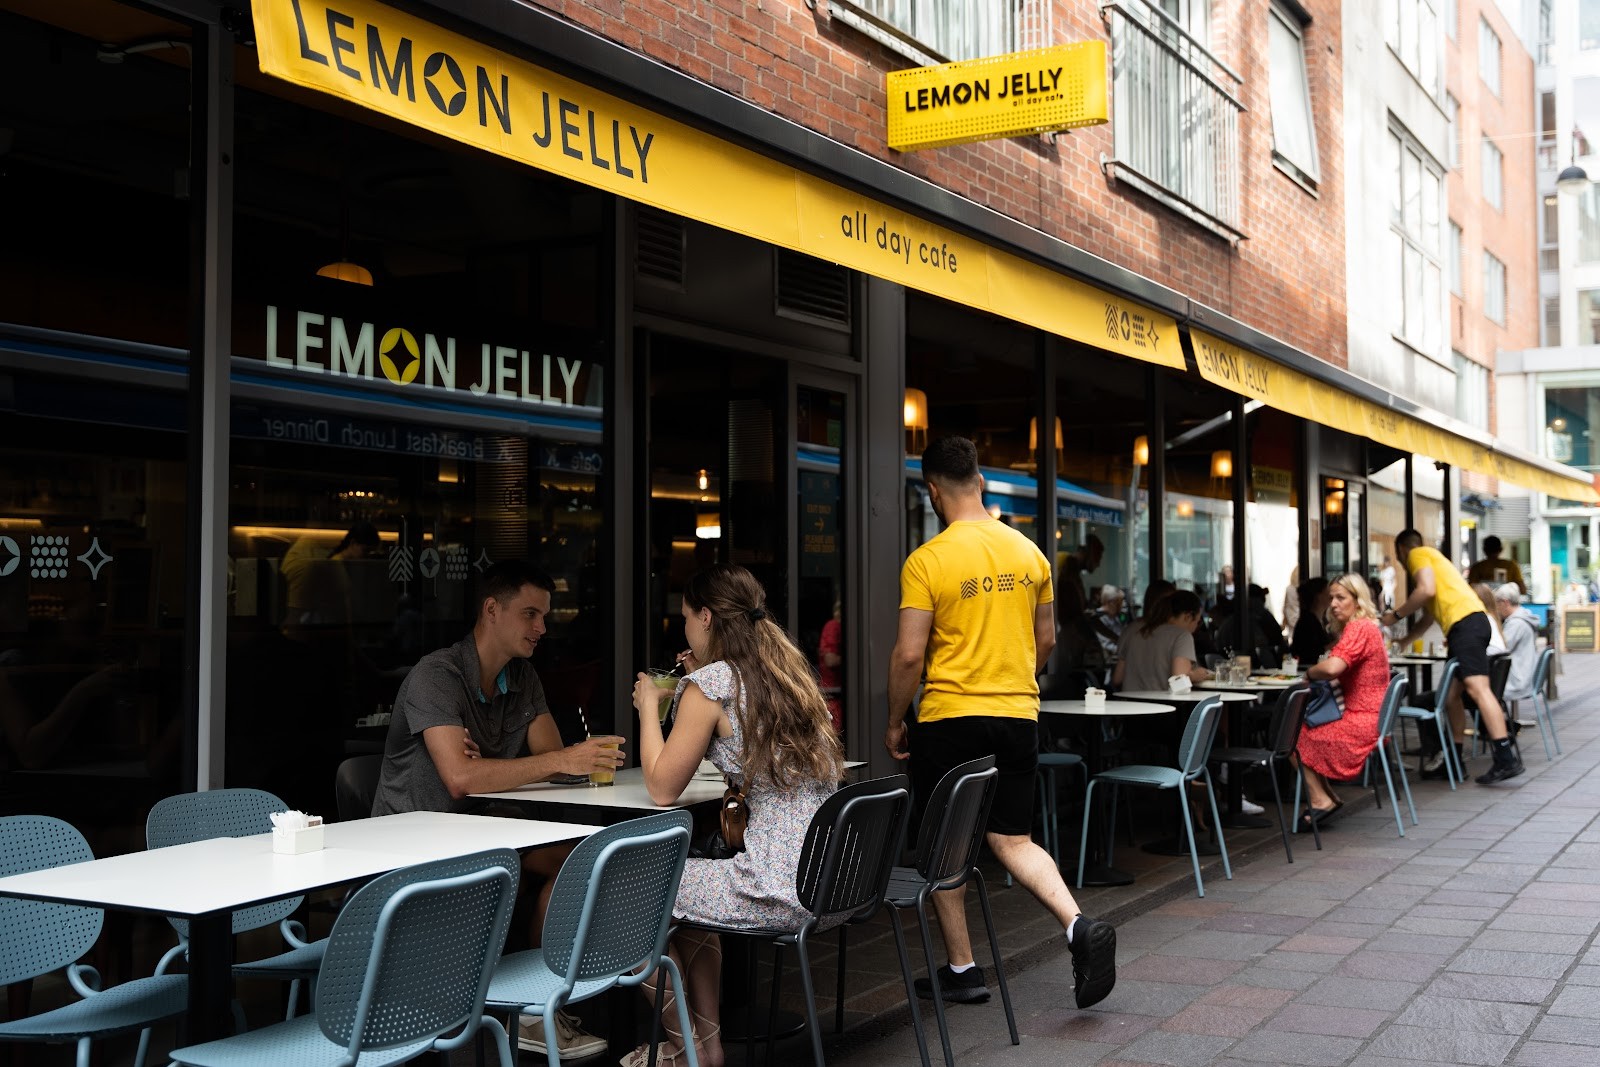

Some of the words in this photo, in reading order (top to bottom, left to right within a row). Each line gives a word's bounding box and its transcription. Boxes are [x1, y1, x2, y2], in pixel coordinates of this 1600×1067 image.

[292, 0, 512, 135] LEMON
[532, 91, 654, 184] JELLY
[905, 79, 990, 113] LEMON
[998, 67, 1063, 99] JELLY
[1013, 98, 1023, 107] all
[1027, 96, 1042, 105] day
[1045, 92, 1064, 102] cafe
[841, 211, 867, 243] all
[876, 221, 911, 264] day
[919, 243, 957, 273] cafe
[267, 305, 456, 392] LEMON
[469, 343, 582, 408] JELLY
